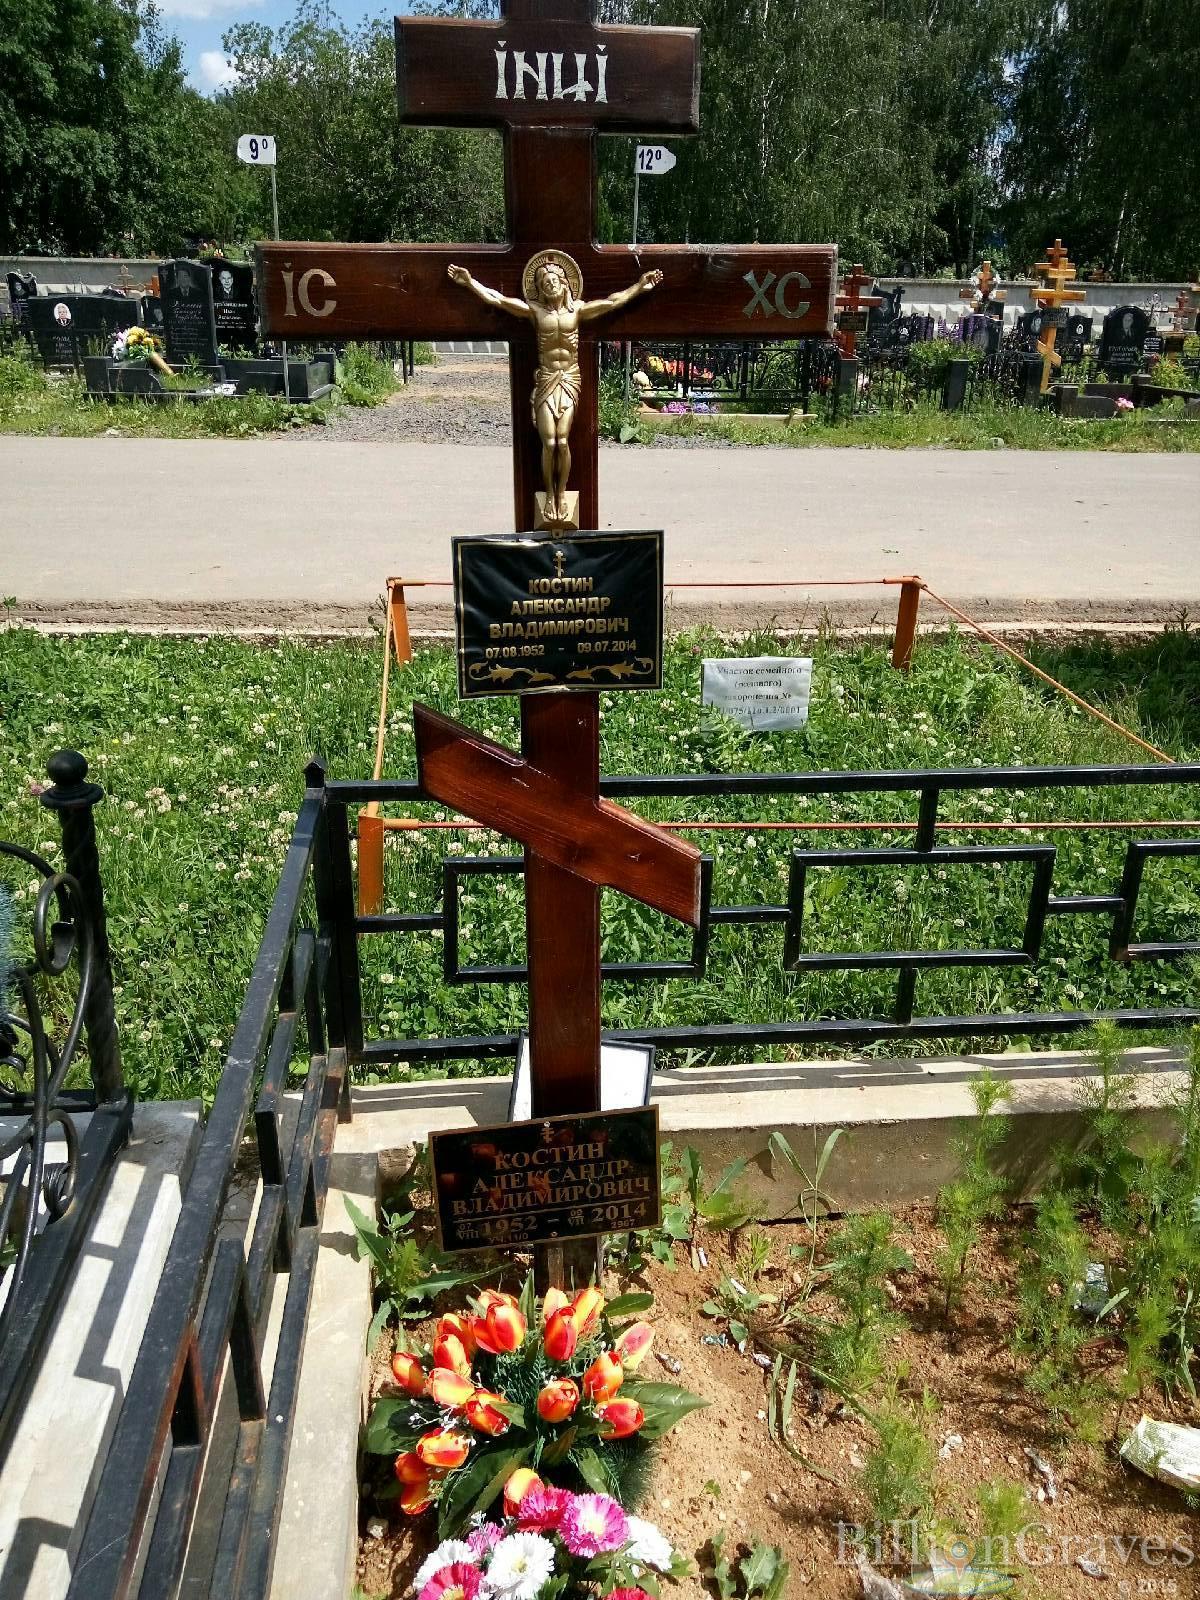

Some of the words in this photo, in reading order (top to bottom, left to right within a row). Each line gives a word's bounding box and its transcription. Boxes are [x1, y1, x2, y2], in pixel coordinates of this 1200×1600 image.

[528, 577, 594, 594] КОСТИН
[511, 597, 611, 616] АЛЕКСАНДР
[489, 617, 629, 639] ВЛАДИМИРОВИЧ
[485, 644, 545, 660] 07.08.1952
[577, 639, 637, 654] 09.07.2014
[495, 1143, 605, 1171] КОСТИН
[473, 1159, 630, 1194] АЛЕКСАНДР
[452, 1176, 650, 1216] ВЛАДИМИРОВИЧ
[591, 1201, 647, 1223] 2014
[481, 1215, 538, 1235] 1952
